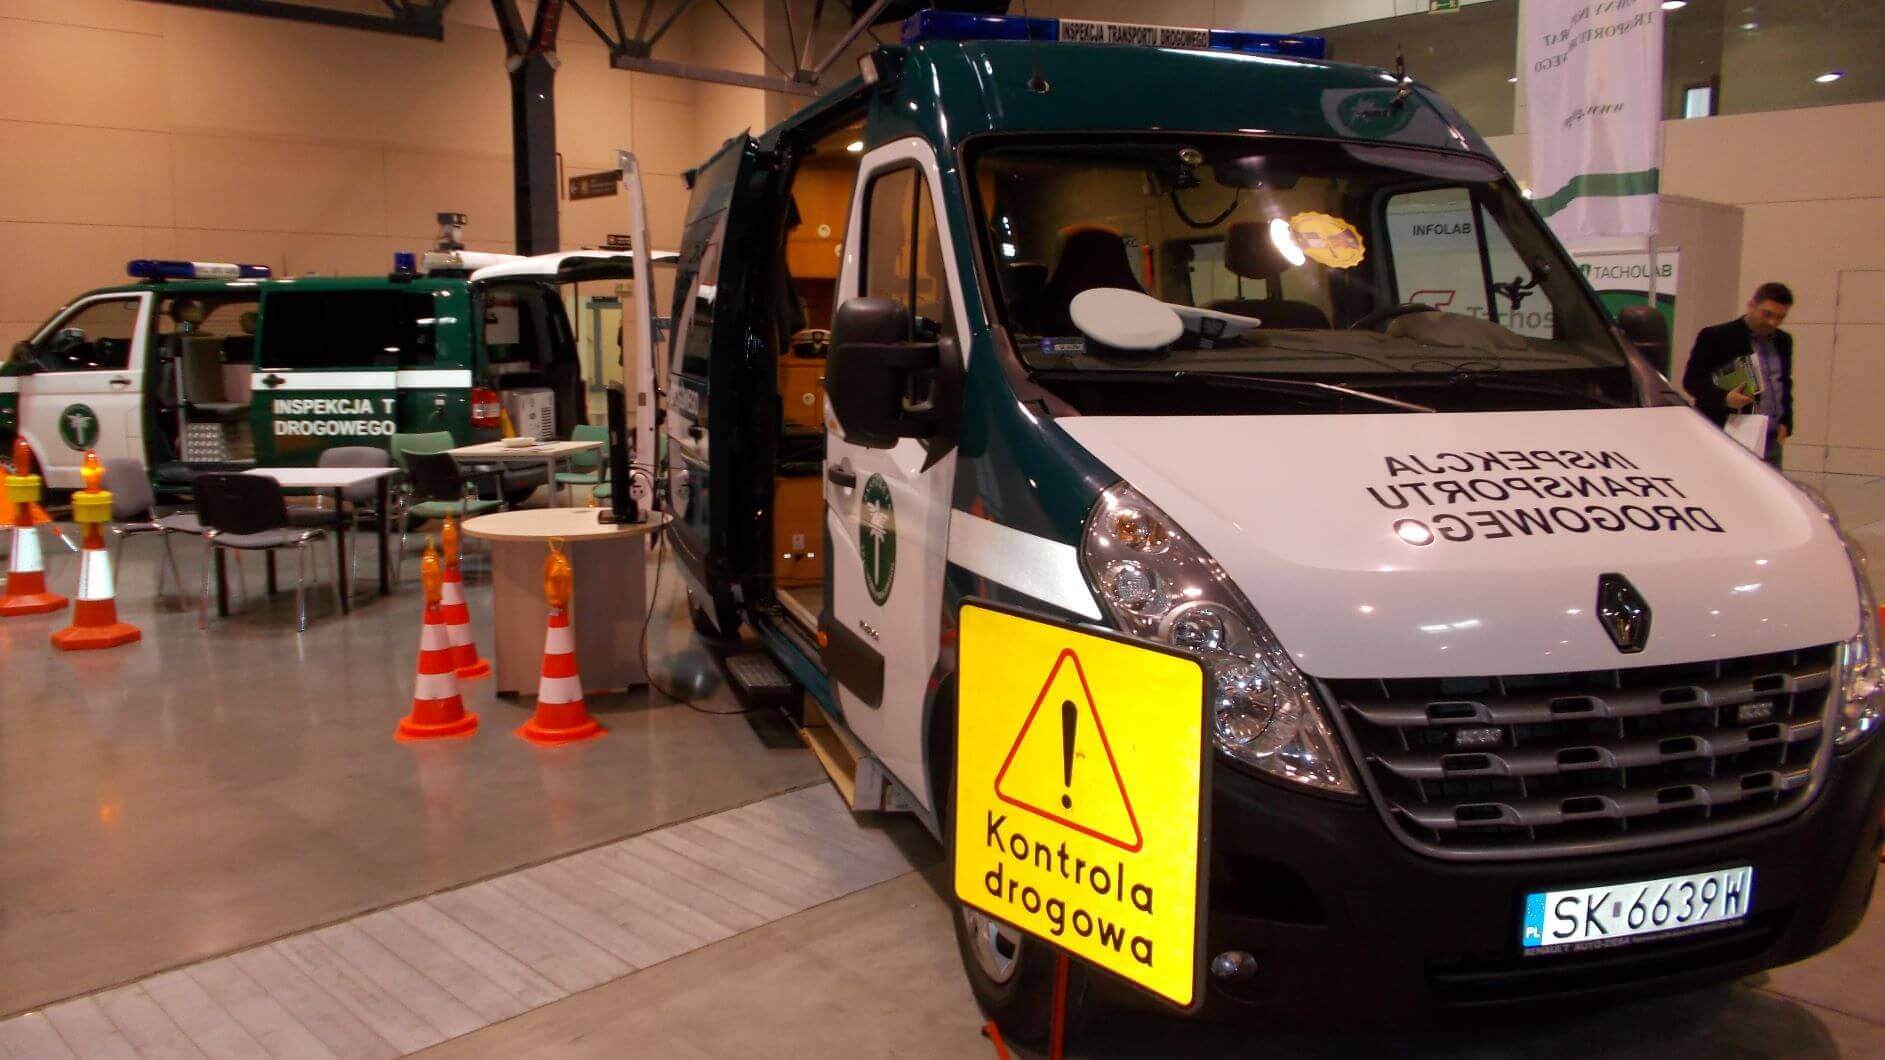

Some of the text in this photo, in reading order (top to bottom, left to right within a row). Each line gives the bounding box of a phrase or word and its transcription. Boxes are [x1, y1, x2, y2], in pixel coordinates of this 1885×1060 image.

[1061, 22, 1207, 48] INSPEKCJA TRANSPORTU DROGOWEGO
[1412, 223, 1471, 236] INFOLAB
[274, 398, 374, 415] INSPEKCJA
[274, 420, 397, 436] DROGOWEGO
[986, 809, 1153, 916] Kontrola
[984, 861, 1153, 968] drogowa
[1525, 926, 1541, 939] PL
[1552, 891, 1613, 939] SK
[1627, 871, 1746, 930] 6639W
